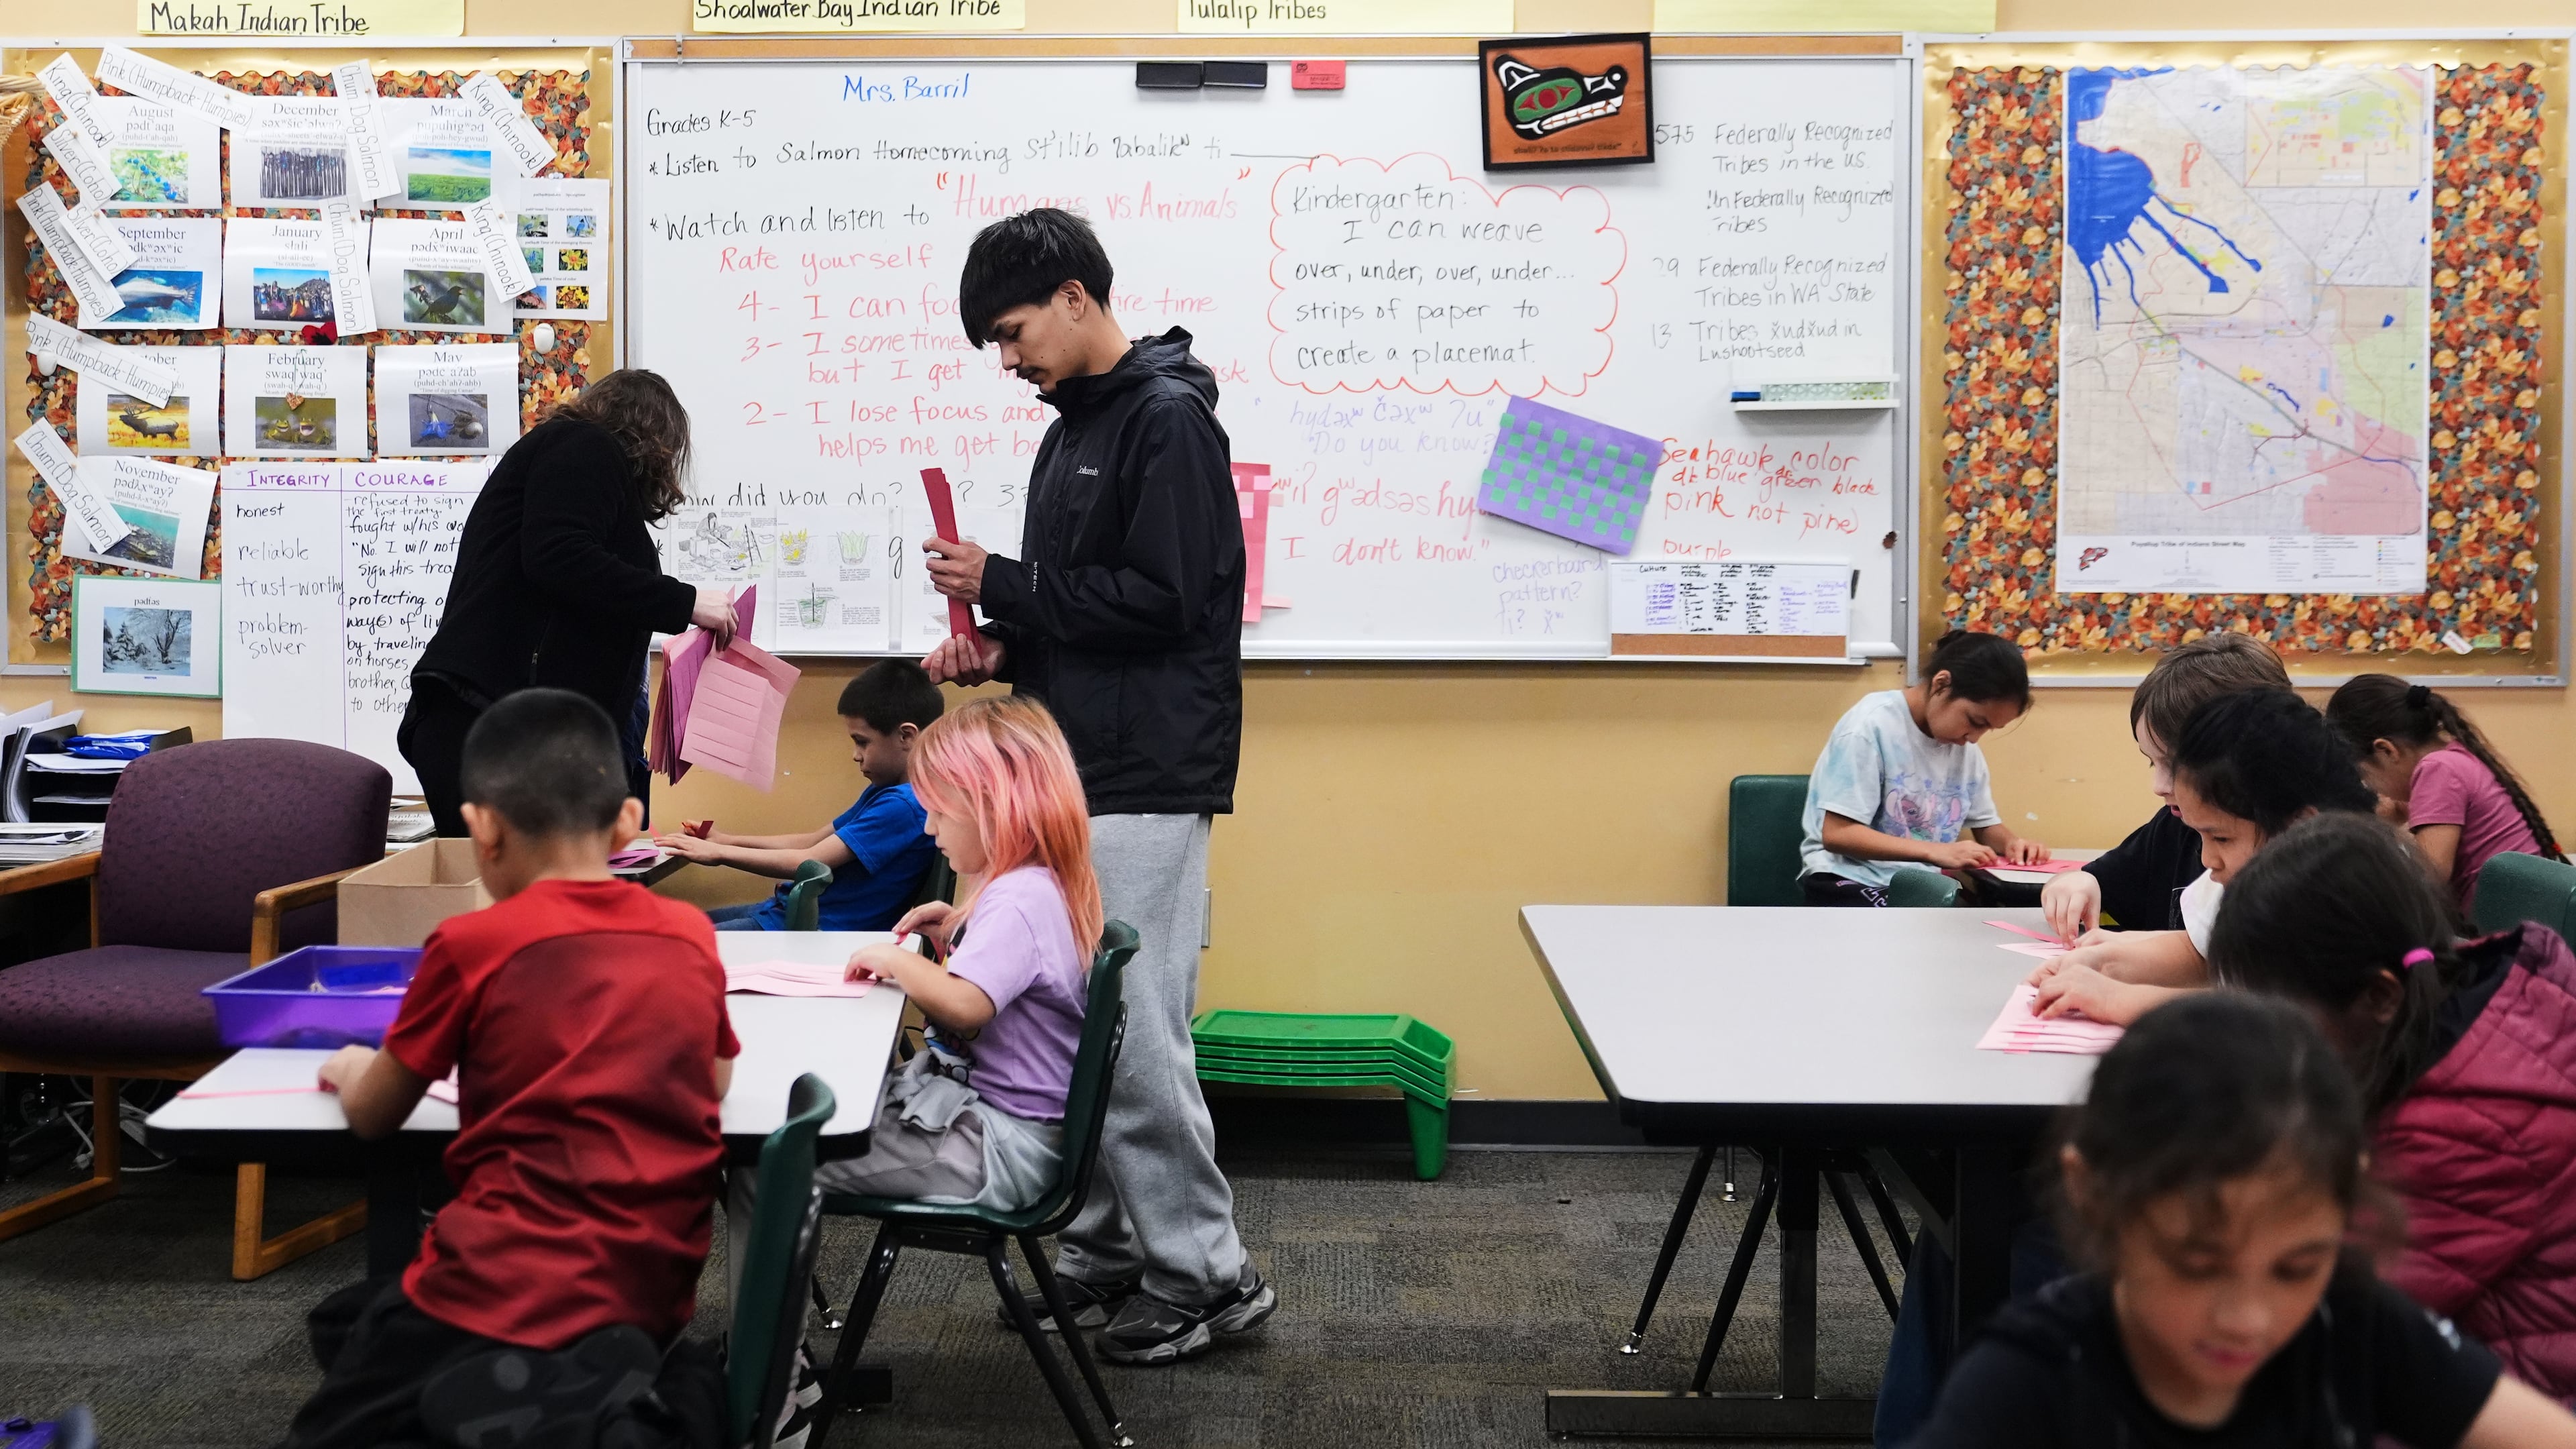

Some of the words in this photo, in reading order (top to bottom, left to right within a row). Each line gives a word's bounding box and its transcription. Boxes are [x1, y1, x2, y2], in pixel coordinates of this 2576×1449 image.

[151, 2, 229, 32] Makah
[237, 3, 308, 32] Indian
[311, 3, 370, 34] Tribe
[695, 0, 810, 19] Shoalwater
[812, 0, 853, 27] Bay
[857, 0, 938, 16] Indian
[101, 53, 125, 81] Pink
[340, 64, 362, 101] Chum
[843, 74, 896, 103] Mrs.
[903, 72, 970, 101] Barril
[273, 103, 339, 116] December
[431, 105, 473, 117] March
[470, 79, 494, 117] King
[128, 105, 174, 123] August
[346, 103, 372, 136] Dog
[647, 107, 710, 137] Grades
[719, 109, 757, 128] K-5
[1654, 123, 1695, 146] 575
[1714, 122, 1796, 154] Federally
[1805, 119, 1894, 150] Recognized
[357, 136, 381, 189] Salmon
[733, 146, 757, 168] to
[776, 140, 861, 164] Salmon
[873, 139, 1012, 174] Homecoming
[1712, 154, 1769, 175] Tribes
[1779, 153, 1799, 170] in
[1803, 151, 1835, 170] the
[1293, 183, 1467, 223] Kindergarten:
[1734, 188, 1806, 217] Federally
[1813, 181, 1894, 223] Recognized
[118, 227, 186, 241] September
[272, 225, 323, 241] January
[329, 203, 350, 239] Chum
[430, 228, 463, 241] April
[665, 212, 748, 241] Watch
[760, 205, 816, 233] and
[828, 208, 886, 231] listen
[903, 203, 930, 225] to
[1342, 219, 1365, 244] I
[1387, 219, 1447, 239] can
[1461, 220, 1544, 244] weave
[718, 246, 780, 273] Rate
[802, 243, 933, 286] yourself
[1295, 262, 1352, 284] over,
[1360, 259, 1424, 286] under,
[1436, 264, 1481, 286] over,
[1699, 256, 1778, 290] Federally
[1784, 252, 1889, 288] Recognized
[339, 278, 366, 333] Salmon)
[804, 294, 830, 320] I
[849, 295, 906, 319] can
[1154, 287, 1218, 315] time
[1694, 286, 1763, 308] Tribes
[1768, 288, 1786, 306] in
[1790, 282, 1821, 306] WA
[1828, 282, 1876, 304] State
[1296, 301, 1365, 329] strips
[1376, 297, 1402, 320] of
[1417, 303, 1492, 334] paper
[1513, 299, 1540, 319] to
[26, 320, 52, 348] Pink
[802, 331, 831, 356] I
[1652, 322, 1672, 350] 13
[1688, 318, 1759, 342] Tribes
[1845, 319, 1864, 337] in
[268, 353, 325, 370] February
[434, 352, 464, 363] May
[1297, 339, 1377, 370] create
[1386, 347, 1399, 362] a
[1411, 337, 1537, 375] placemat.
[1699, 339, 1806, 363] Lushootseed
[808, 358, 865, 384] but
[890, 359, 913, 381] I
[928, 358, 967, 392] get
[805, 400, 831, 425] I
[851, 400, 899, 423] lose
[908, 396, 988, 425] focus
[1002, 400, 1046, 424] and
[25, 431, 55, 470] Chum
[818, 432, 888, 468] helps
[900, 435, 940, 457] me
[955, 431, 1001, 472] get
[1359, 436, 1403, 466] you
[1658, 437, 1775, 470] Seahawk
[1789, 440, 1861, 472] color
[114, 460, 181, 485] November
[247, 469, 330, 488] INTEGRITY
[355, 471, 448, 487] COURAGE
[1706, 464, 1748, 485] blue
[1760, 474, 1823, 504] green
[1832, 474, 1880, 496] black
[237, 502, 284, 519] honest
[345, 506, 366, 517] the
[373, 506, 396, 517] first
[414, 494, 428, 507] to
[433, 495, 464, 511] sign
[1665, 485, 1735, 521] pink
[1747, 501, 1790, 525] not
[403, 518, 440, 533] w/his
[238, 537, 310, 561] reliable
[386, 541, 398, 553] I
[405, 539, 427, 554] will
[433, 537, 460, 553] not
[1280, 536, 1307, 561] I
[1332, 537, 1403, 566] don't
[358, 562, 386, 588] sign
[388, 560, 414, 578] this
[1492, 554, 1606, 584] checkerboard
[1639, 565, 1668, 574] Culture
[348, 590, 427, 616] protecting
[1499, 580, 1583, 614] pattern?
[238, 612, 308, 645] problem-
[400, 612, 419, 633] of
[249, 637, 307, 659] solver
[347, 634, 369, 657] by
[347, 656, 362, 667] on
[366, 653, 409, 669] horses
[350, 698, 363, 712] to
